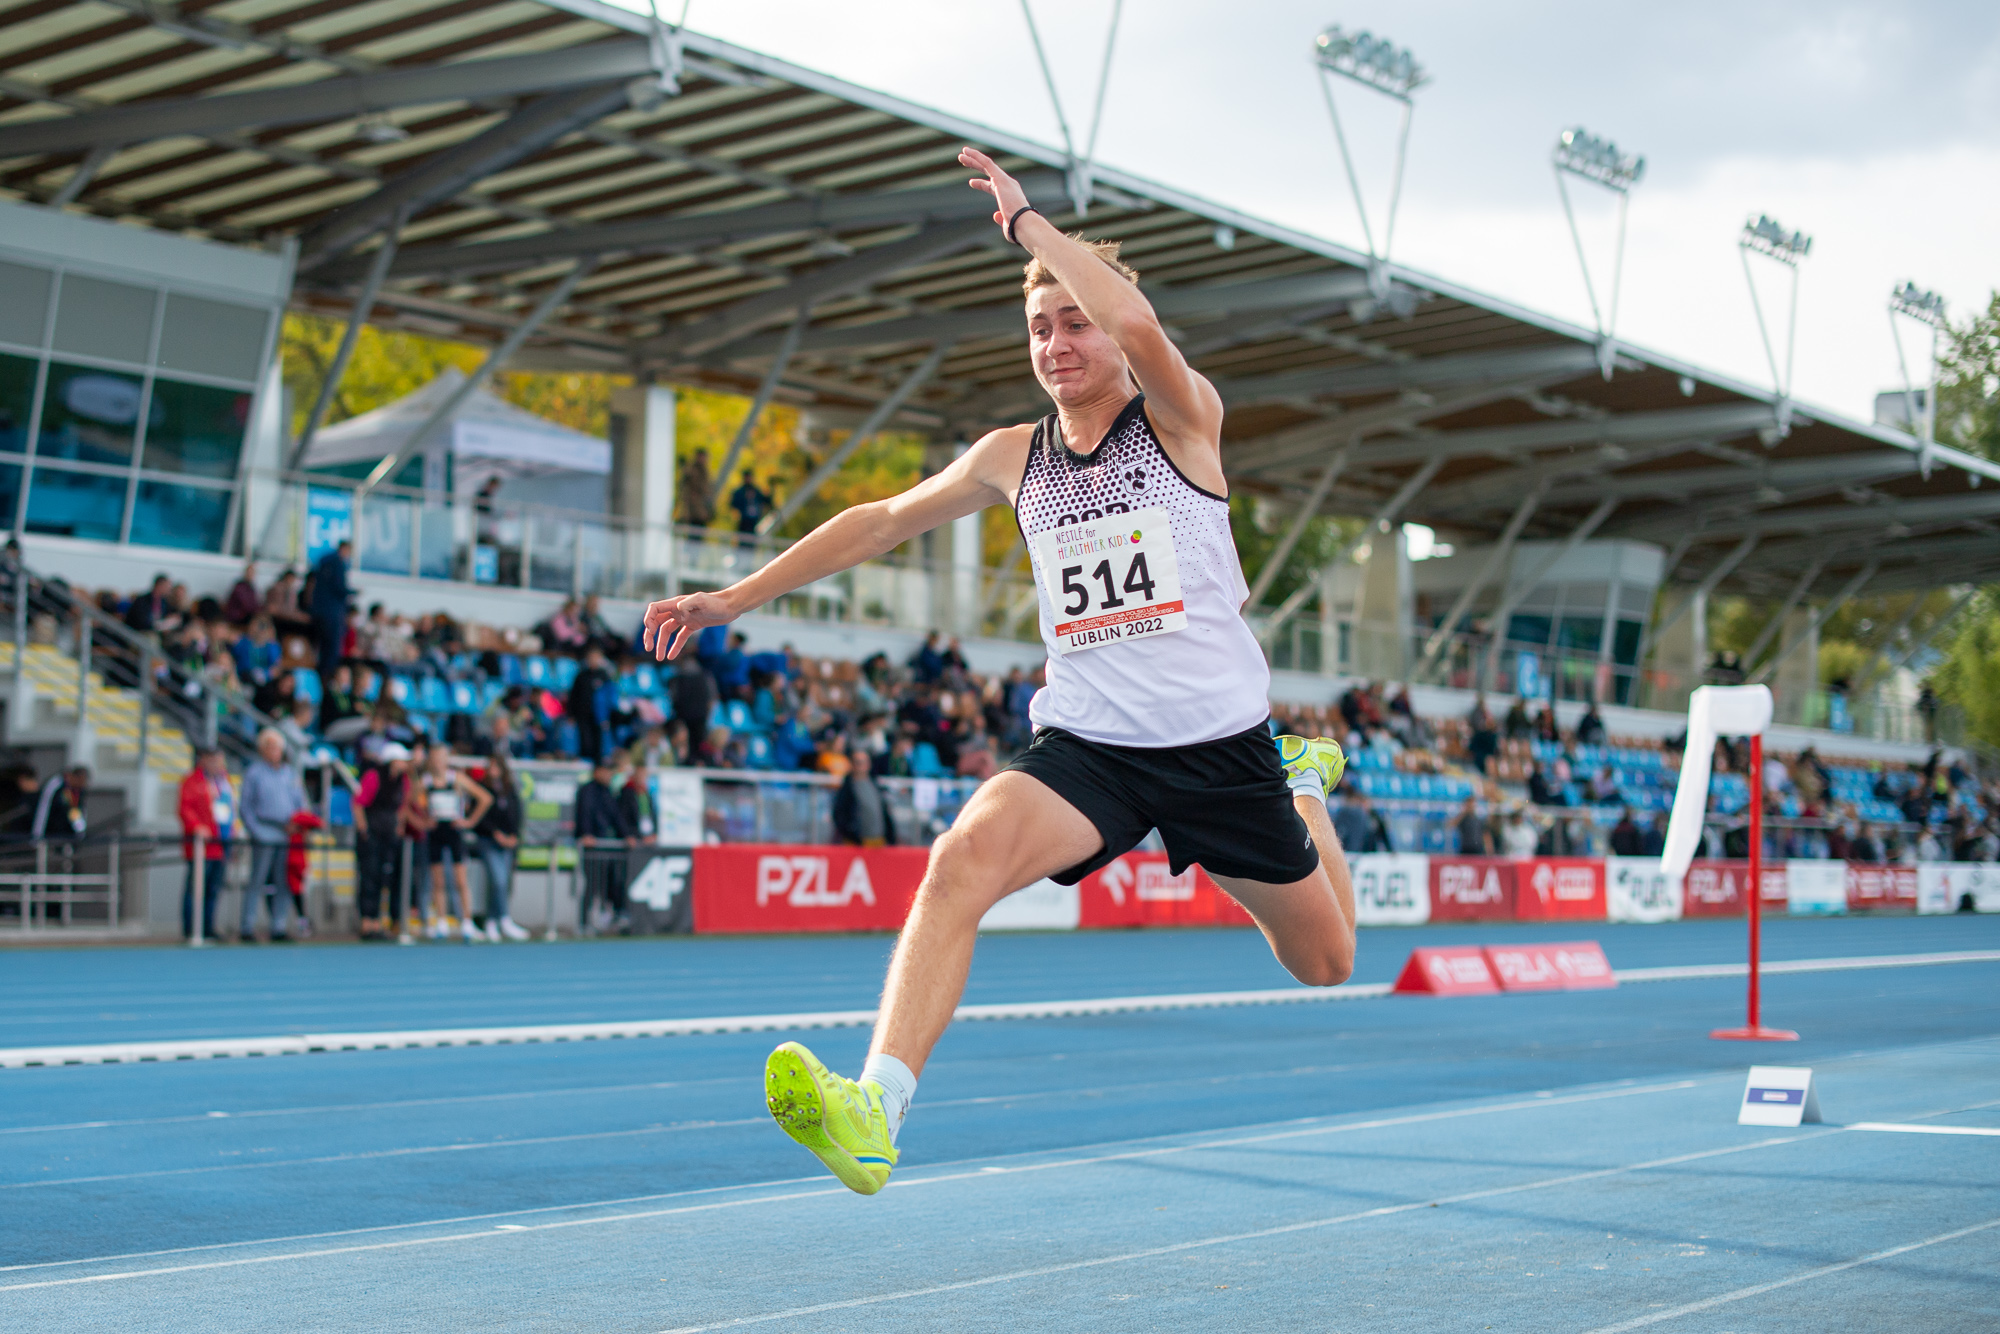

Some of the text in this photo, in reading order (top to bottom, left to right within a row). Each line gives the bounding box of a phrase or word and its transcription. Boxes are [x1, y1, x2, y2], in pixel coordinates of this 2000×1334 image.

[1056, 527, 1096, 545] NESTLÉ for
[1058, 534, 1129, 560] HEALTHIER KIDS
[1062, 552, 1155, 616] 514
[1070, 618, 1164, 647] LUBLIN 2022
[628, 855, 692, 910] 4F
[756, 856, 876, 906] PZLA
[1439, 864, 1504, 905] PZLA
